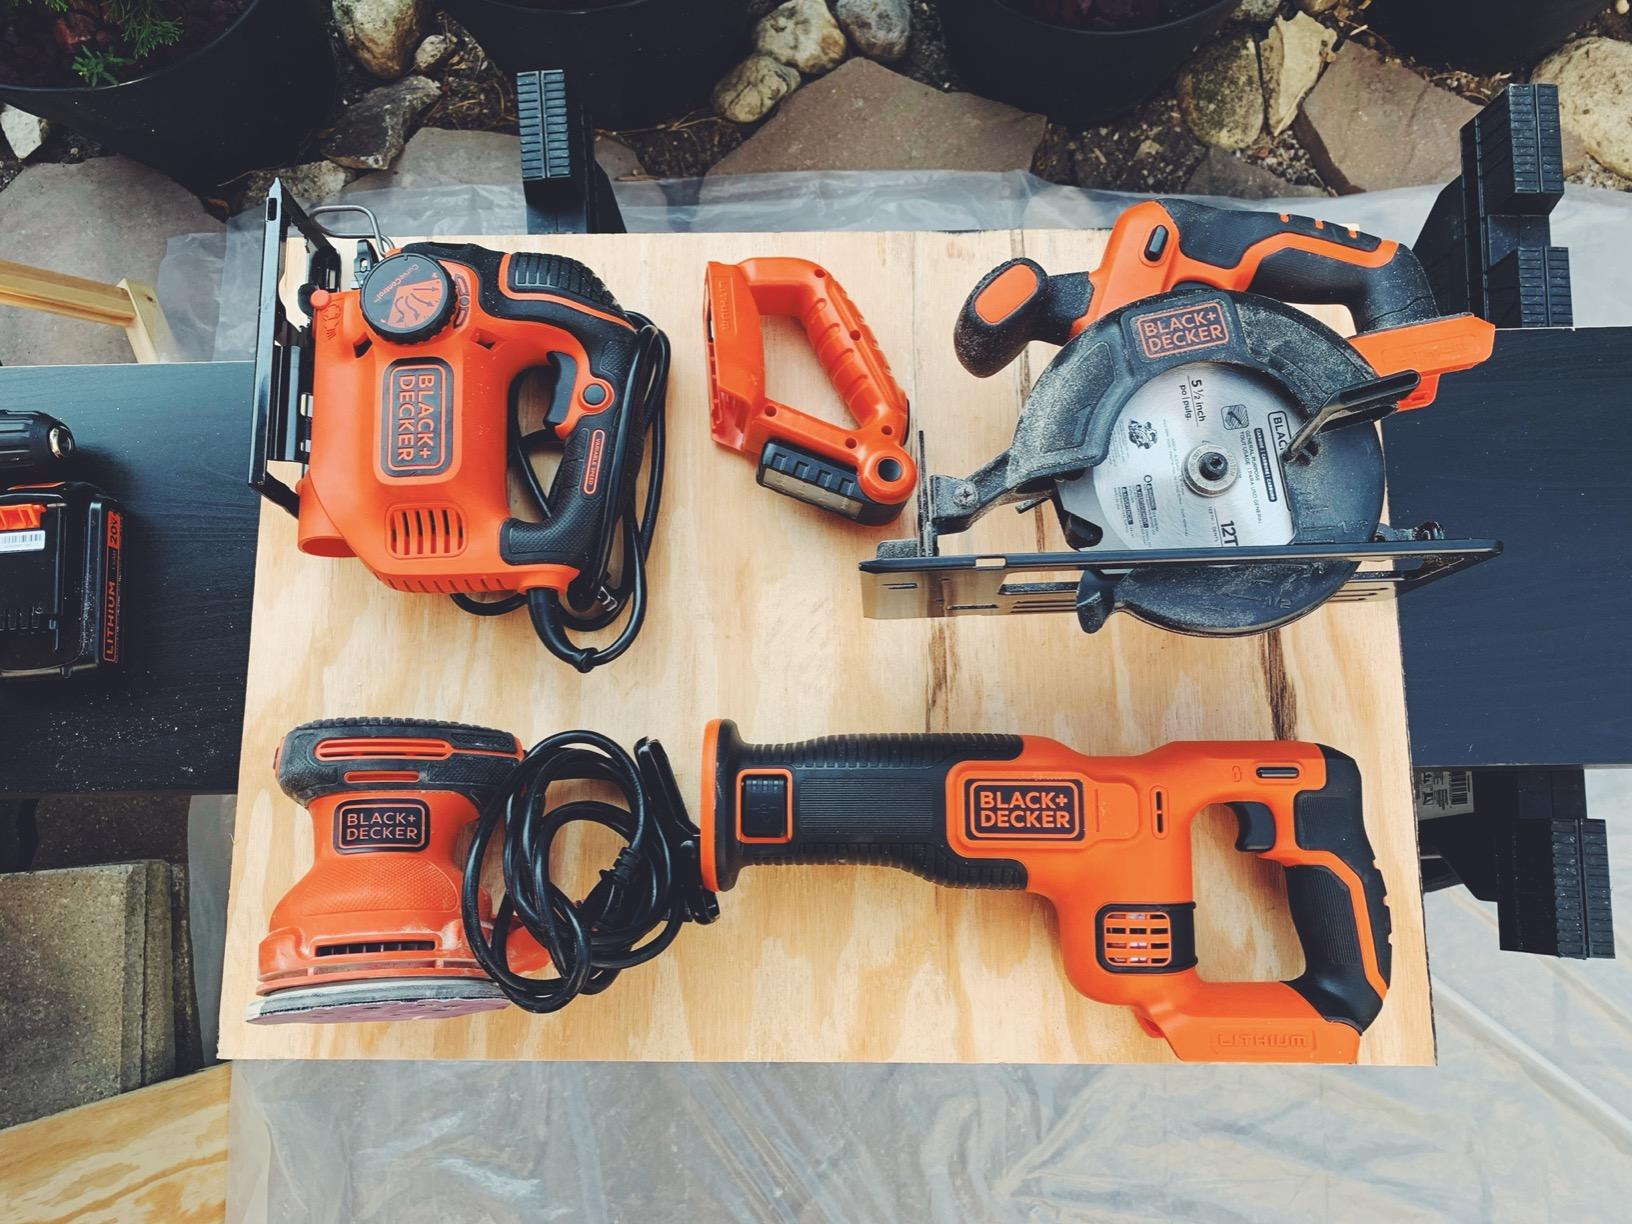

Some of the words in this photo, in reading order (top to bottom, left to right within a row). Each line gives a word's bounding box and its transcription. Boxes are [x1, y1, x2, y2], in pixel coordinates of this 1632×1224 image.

[1144, 311, 1216, 336] BLACK+
[1148, 324, 1223, 352] DECKER
[1191, 379, 1203, 388] 5
[398, 374, 415, 461] DECKER
[418, 374, 435, 459] BLACK+
[1196, 401, 1206, 422] inch
[1273, 416, 1288, 451] BLAC
[592, 439, 601, 465] VARIABLE
[588, 467, 597, 485] SPEED
[1221, 520, 1239, 547] 12T
[105, 581, 116, 655] LITHIUM
[980, 791, 1068, 809] BLACK+
[347, 812, 417, 826] BLACK+
[980, 810, 1070, 828] DECKER
[346, 827, 418, 841] DECKER
[1218, 1034, 1305, 1048] LITHIUM
